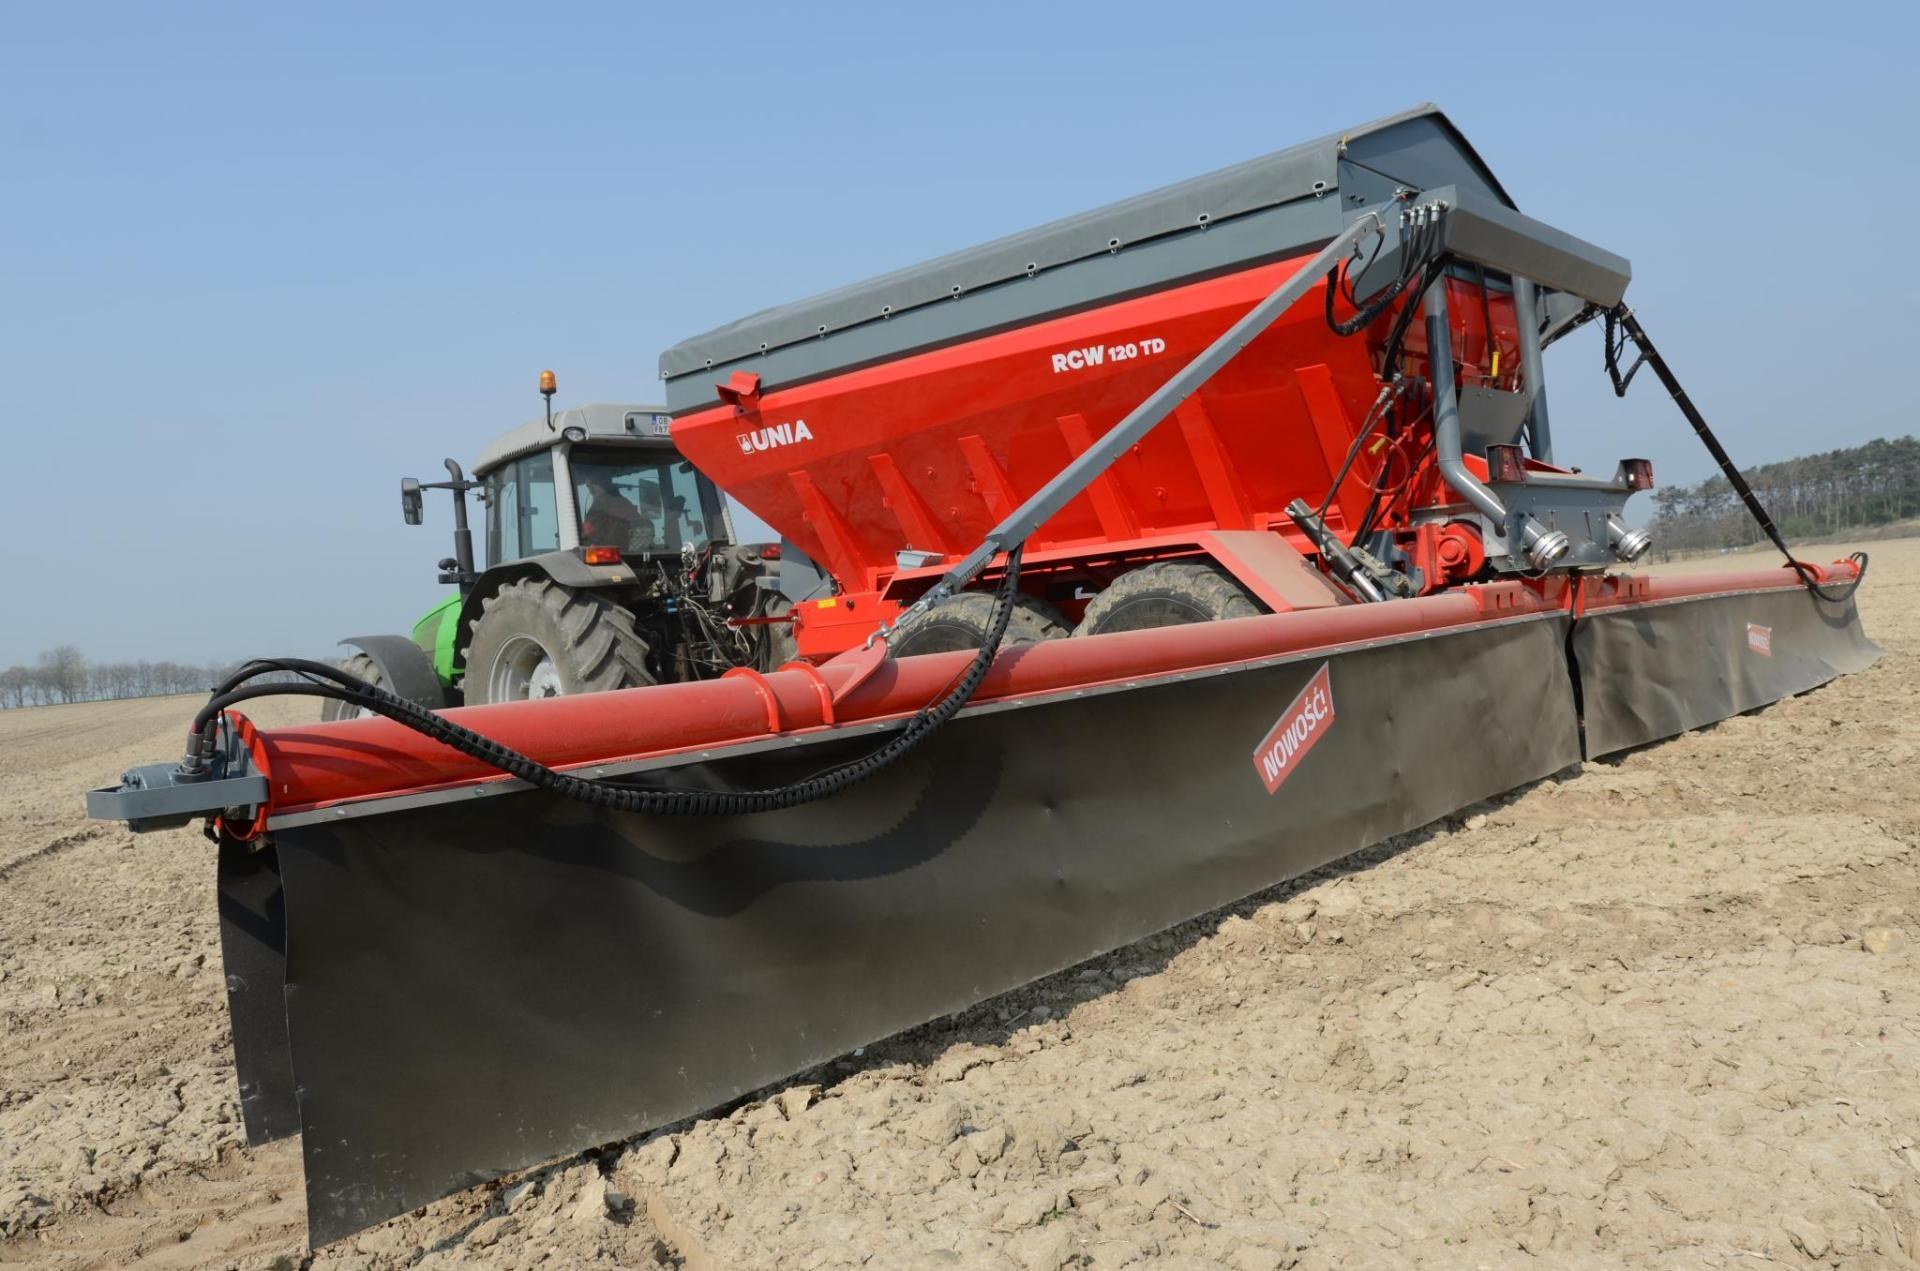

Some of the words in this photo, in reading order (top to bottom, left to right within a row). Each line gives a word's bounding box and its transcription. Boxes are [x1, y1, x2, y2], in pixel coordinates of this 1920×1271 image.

[1052, 345, 1104, 373] RCW
[1108, 343, 1138, 362] 120
[1140, 338, 1166, 356] TD
[750, 420, 814, 451] UNIA
[1263, 686, 1328, 783] NOWOŚĆ!
